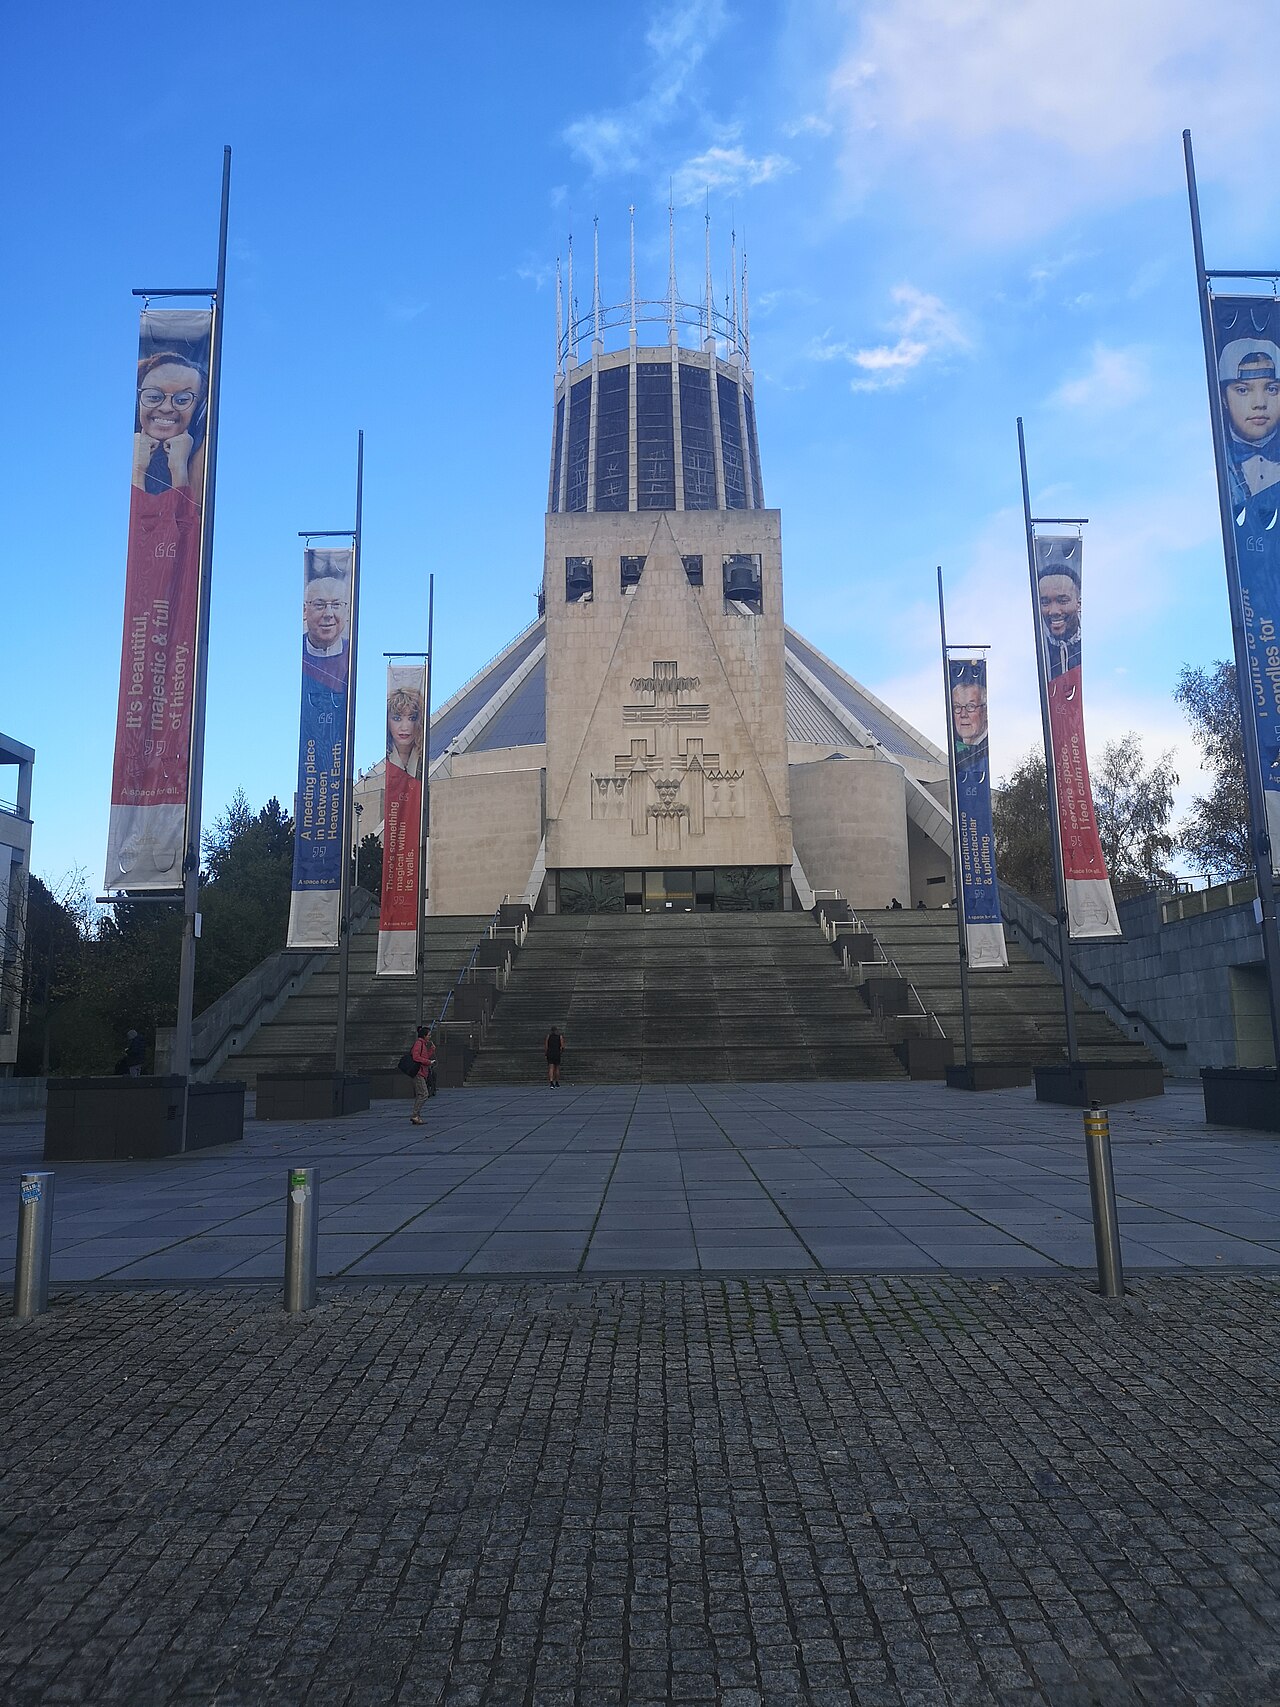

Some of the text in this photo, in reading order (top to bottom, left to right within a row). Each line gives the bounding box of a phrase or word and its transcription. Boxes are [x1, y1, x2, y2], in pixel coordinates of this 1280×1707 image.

[1259, 617, 1276, 643] for
[126, 611, 150, 728] It's beautiful,
[149, 599, 170, 731] majestic & full
[169, 641, 190, 730] of history.
[1061, 744, 1073, 784] space.
[1070, 733, 1081, 763] here.
[301, 739, 317, 841] A meeting place
[314, 771, 328, 841] in between
[327, 740, 342, 840] Heaven & Earth.
[1066, 787, 1079, 830] serene
[1075, 767, 1085, 796] calm
[1077, 800, 1090, 823] feel
[386, 801, 400, 891] There's something
[396, 821, 406, 891] magical within
[405, 848, 414, 891] its walls.
[961, 811, 971, 871] architecture
[969, 817, 983, 885] is spectacular
[980, 833, 993, 885] & uplifting.
